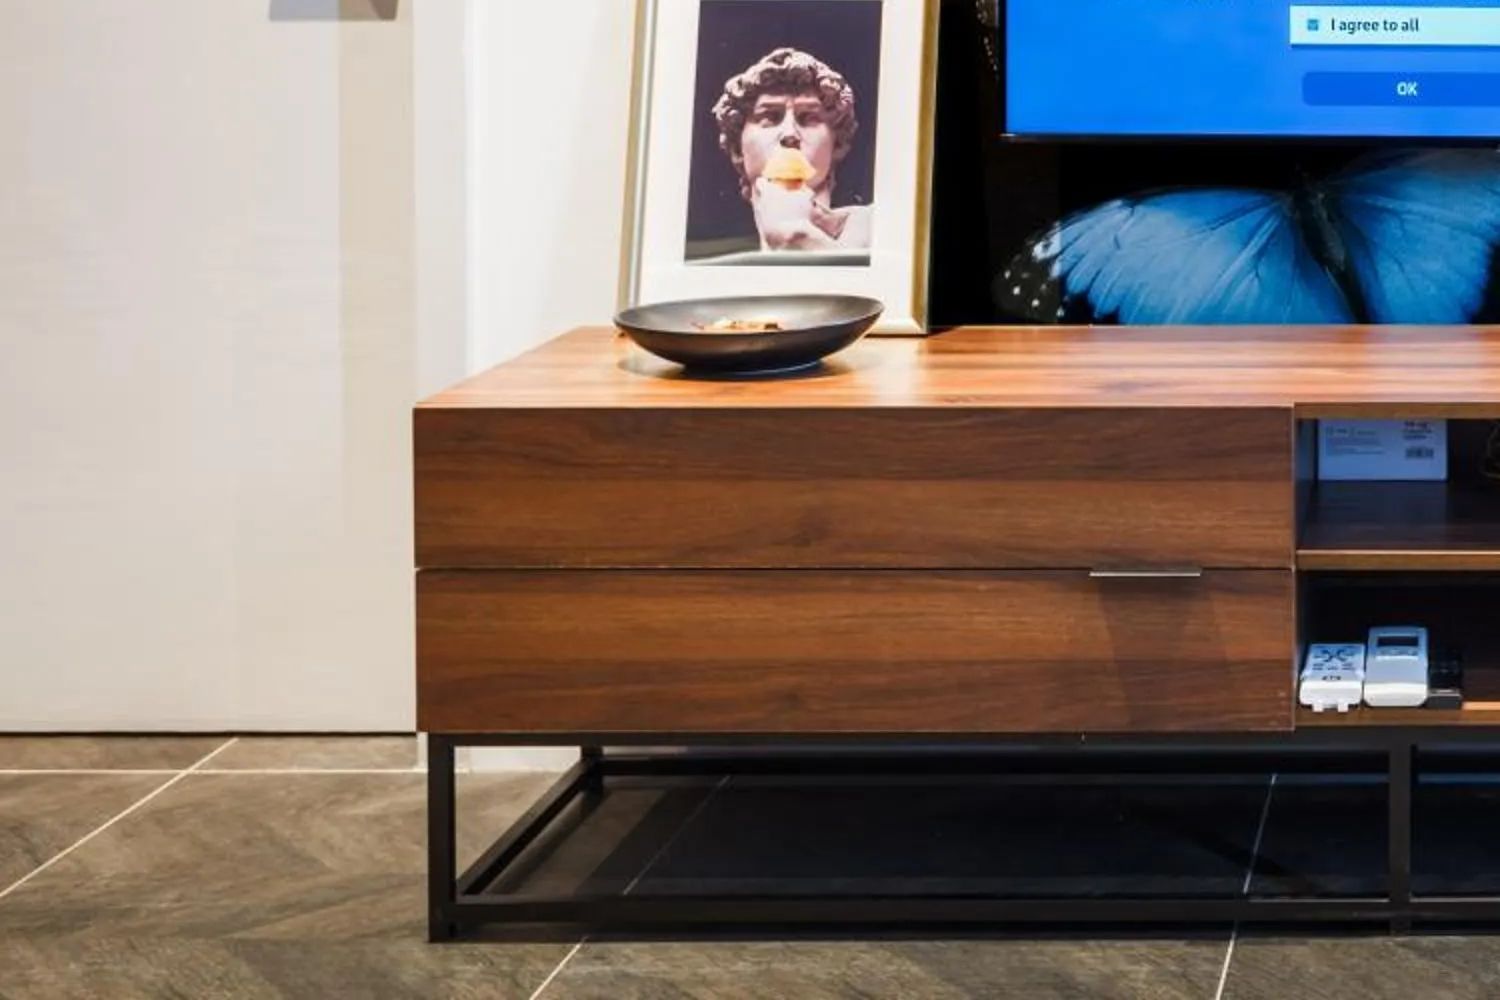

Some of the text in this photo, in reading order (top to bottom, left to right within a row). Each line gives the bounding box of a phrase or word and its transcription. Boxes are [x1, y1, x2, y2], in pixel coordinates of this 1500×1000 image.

[1331, 17, 1420, 35] I agree to all
[1396, 81, 1418, 96] OK
